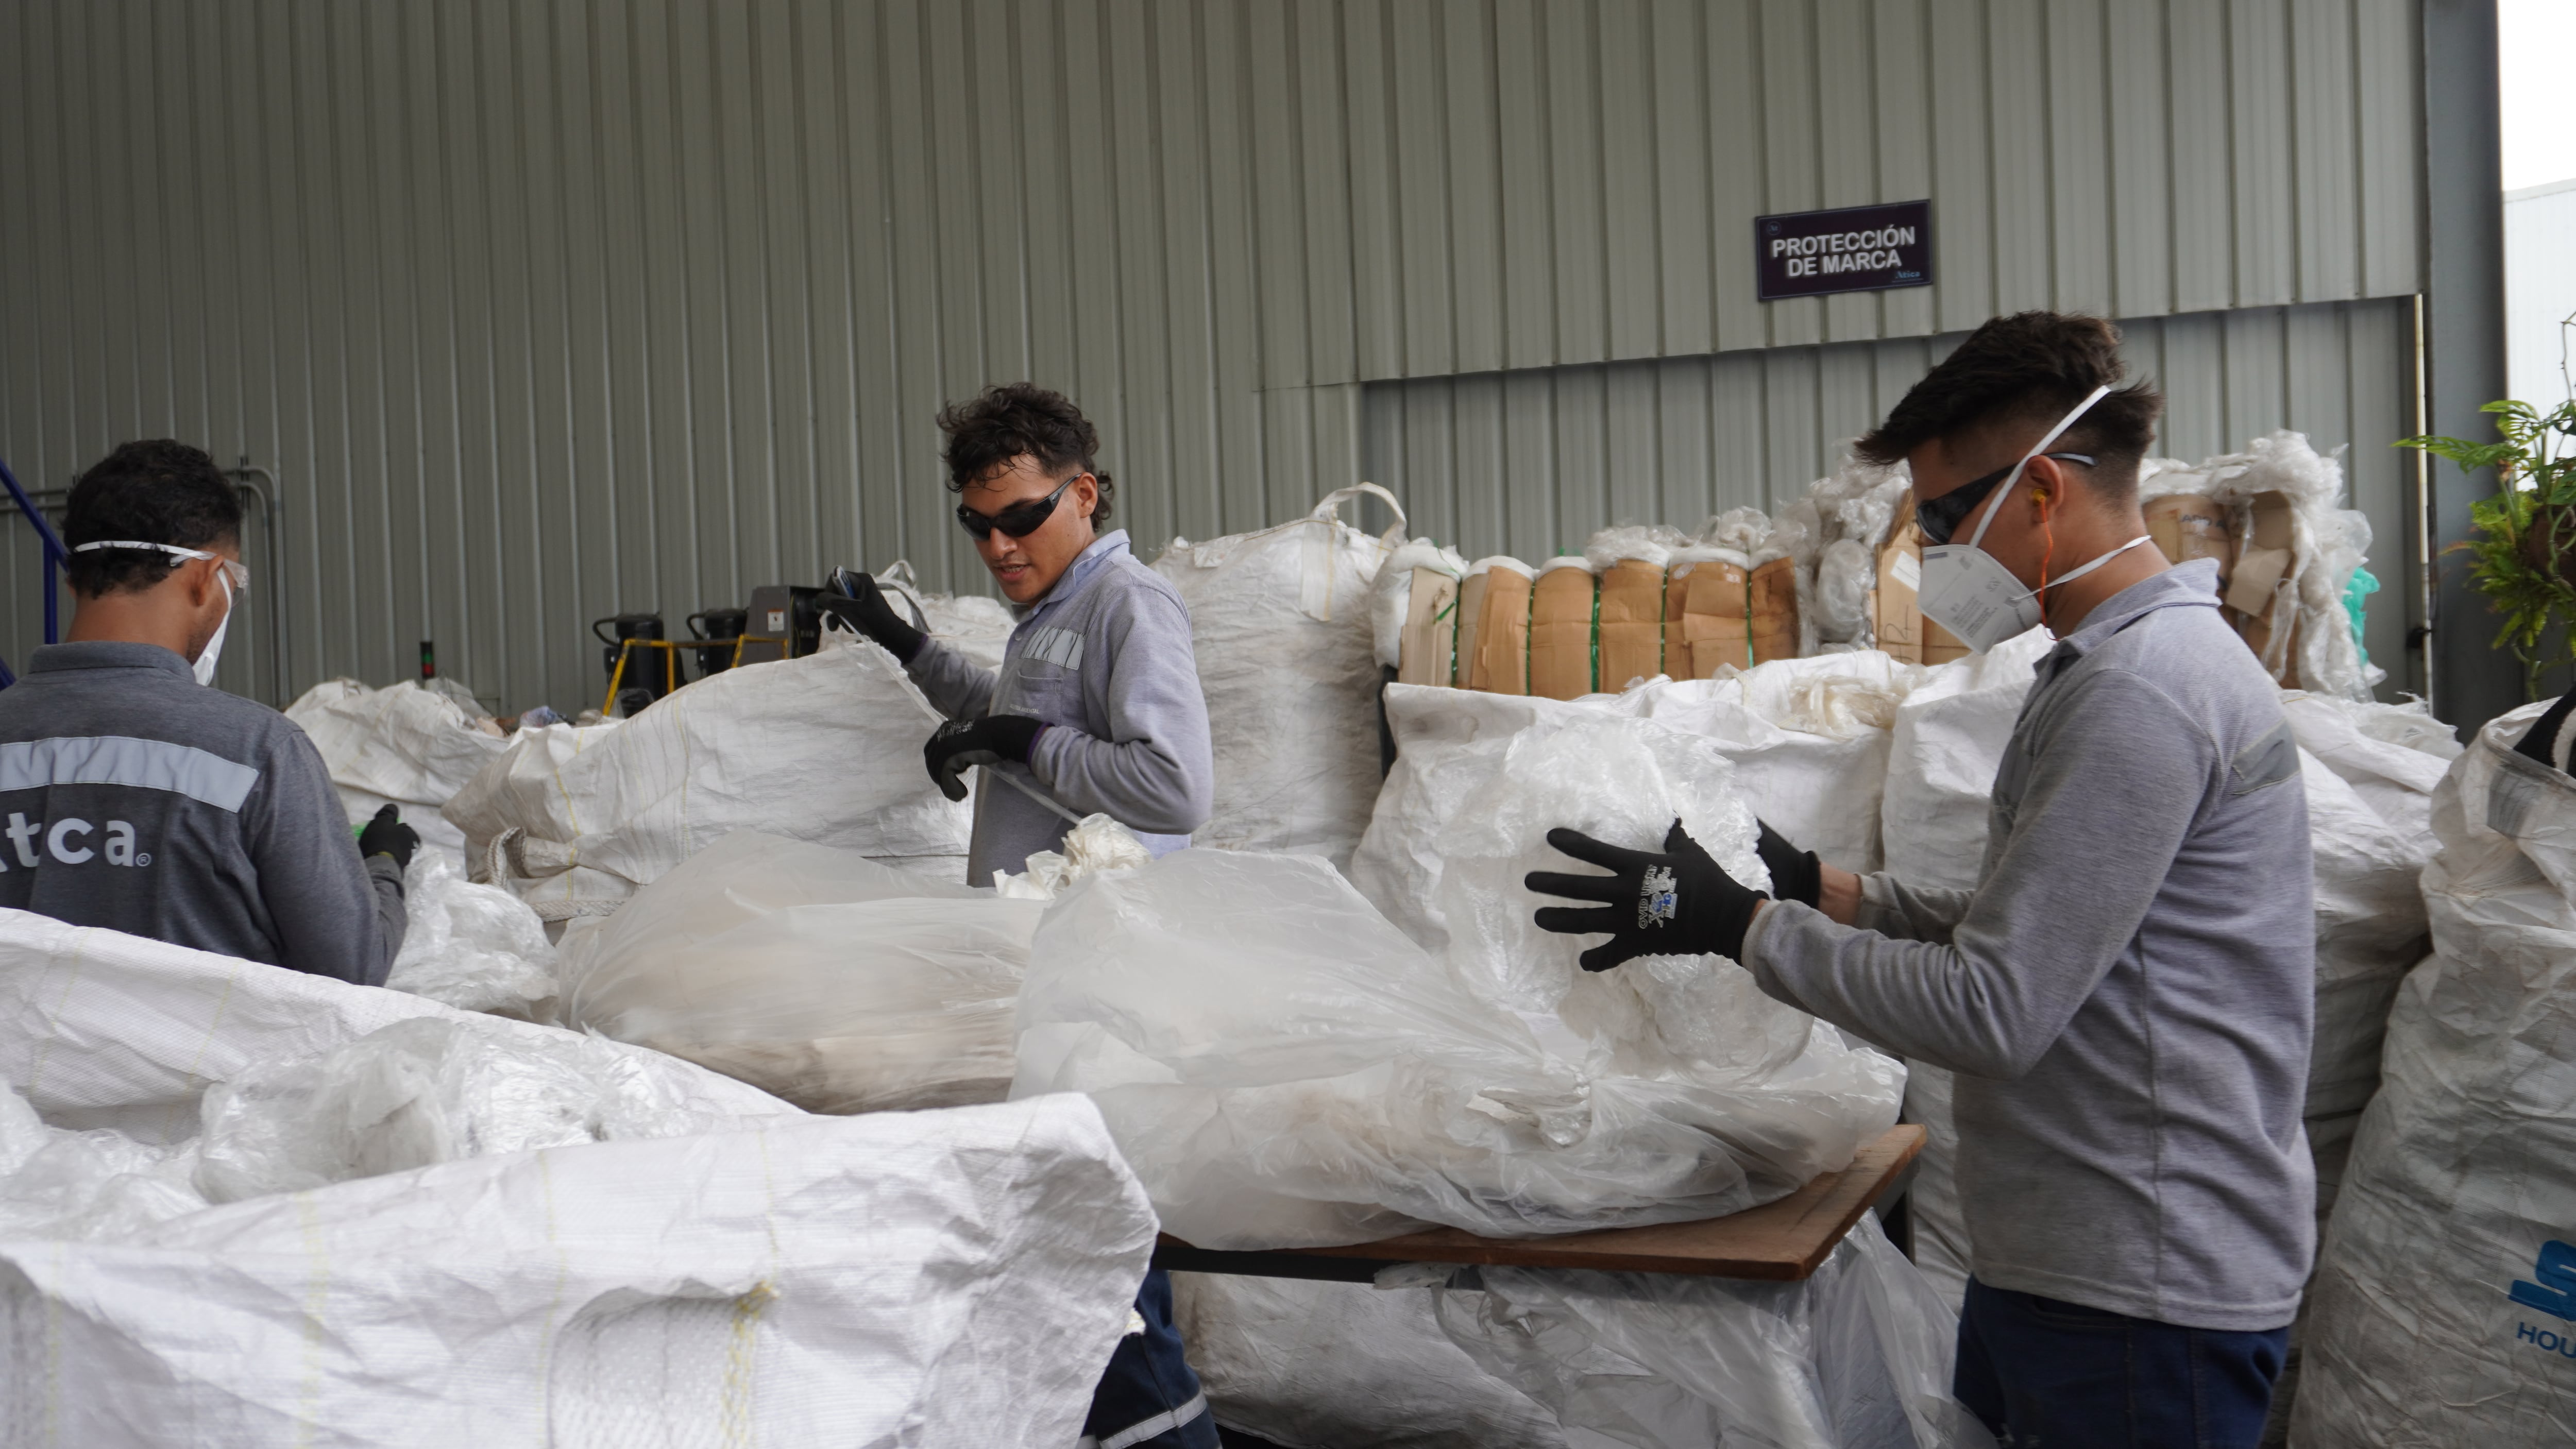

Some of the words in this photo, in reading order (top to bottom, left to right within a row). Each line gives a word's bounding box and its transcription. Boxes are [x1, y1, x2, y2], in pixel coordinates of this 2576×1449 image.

[1771, 224, 1916, 258] PROTECCIÓN
[1788, 257, 1818, 277] DE
[1822, 249, 1902, 274] MARCA
